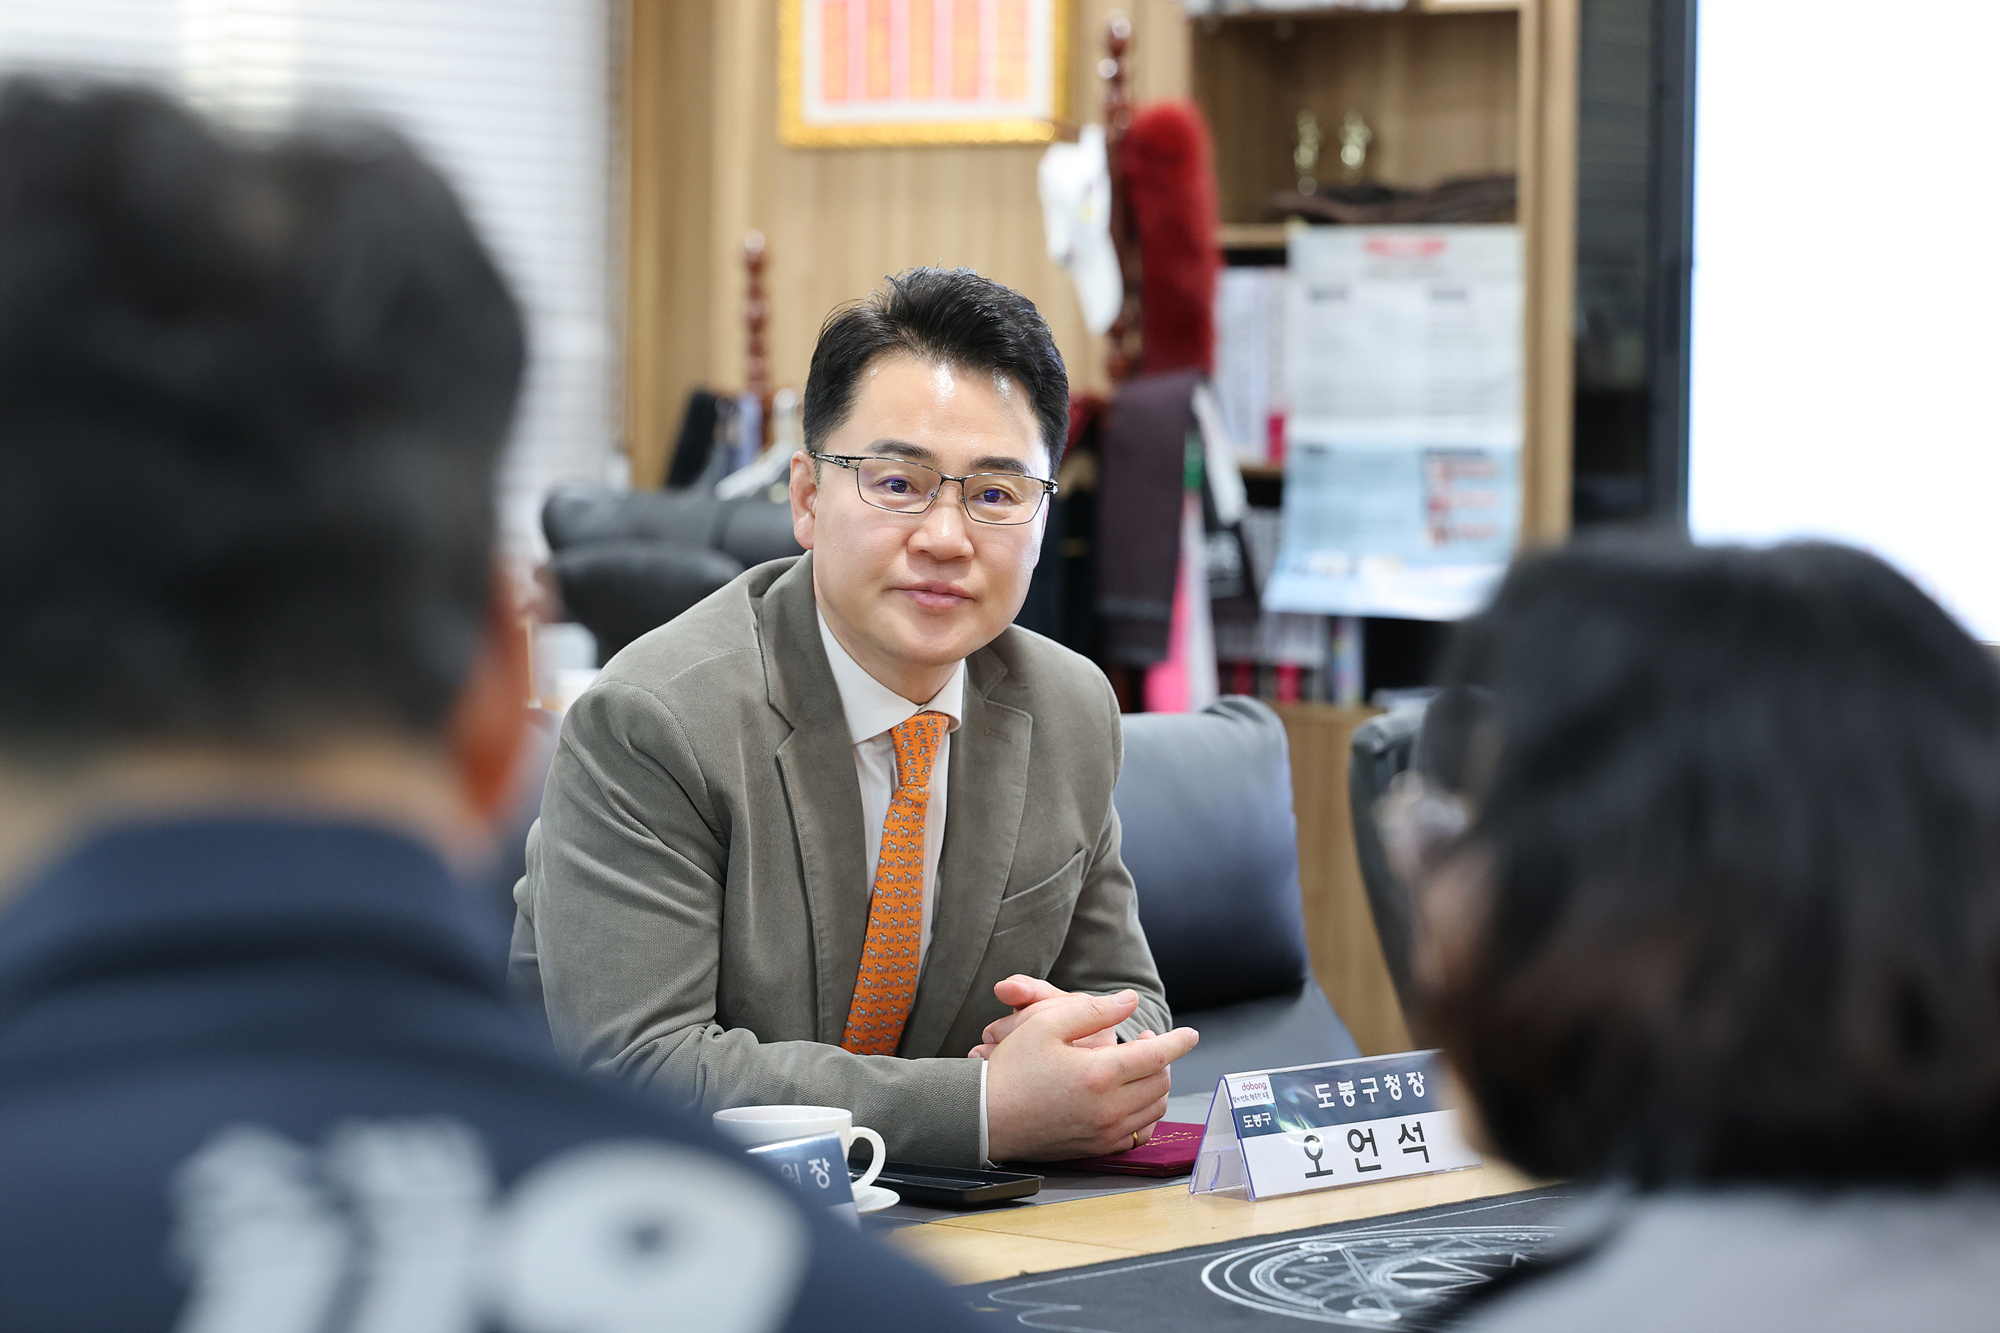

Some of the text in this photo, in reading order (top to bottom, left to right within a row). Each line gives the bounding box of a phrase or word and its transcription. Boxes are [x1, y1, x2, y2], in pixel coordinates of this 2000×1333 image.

[1241, 1082, 1267, 1091] dobong
[1314, 1071, 1425, 1108] 도봉구청장
[1242, 1112, 1272, 1128] 도봉구
